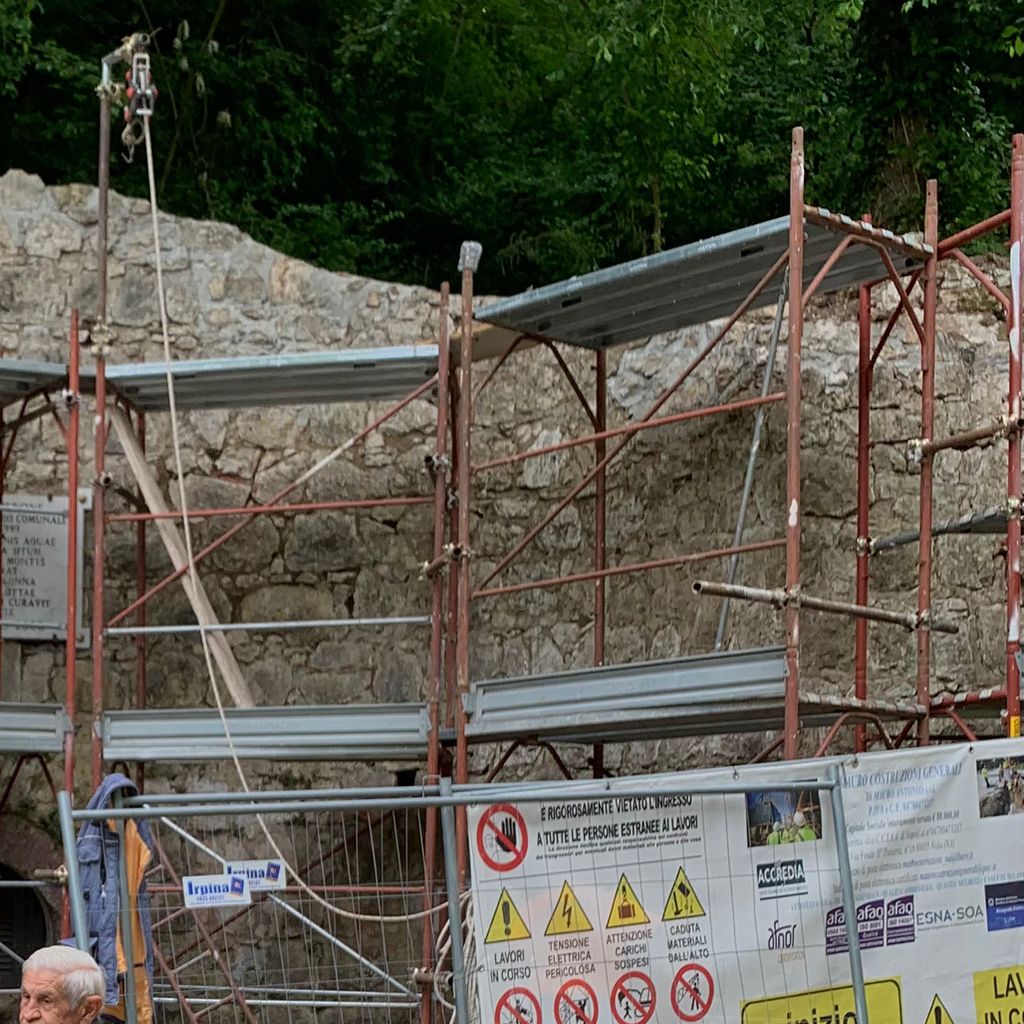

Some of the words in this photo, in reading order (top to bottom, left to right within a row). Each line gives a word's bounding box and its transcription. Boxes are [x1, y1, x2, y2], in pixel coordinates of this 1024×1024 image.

[548, 800, 614, 821] RIGOROSAMENTE
[615, 797, 648, 814] VIETATO
[537, 832, 542, 846] A
[544, 830, 569, 846] TUTTE
[571, 828, 581, 842] LE
[583, 824, 618, 841] PERSONE
[621, 820, 660, 837] ESTRANEE
[662, 818, 670, 832] AI
[672, 815, 698, 831] LAVORI
[227, 865, 265, 879] Iina
[758, 864, 805, 884] ACCREDIA
[188, 881, 230, 896] Irpina
[857, 904, 884, 922] afaq
[888, 900, 913, 916] afaq
[826, 910, 846, 926] afa
[606, 929, 653, 945] ATTENZIONE
[670, 922, 700, 936] CADUTA
[548, 937, 590, 951] TENSIONE
[615, 943, 648, 957] CARICHI
[668, 935, 708, 950] MATERIALI
[494, 949, 525, 965] LAVORI
[548, 950, 592, 966] ELETTRICA
[614, 957, 650, 971] SOSPESI
[668, 948, 710, 964] DALL'ALTO
[490, 970, 500, 983] IN
[502, 966, 531, 982] CORSO
[546, 963, 596, 979] PERICOLOSA
